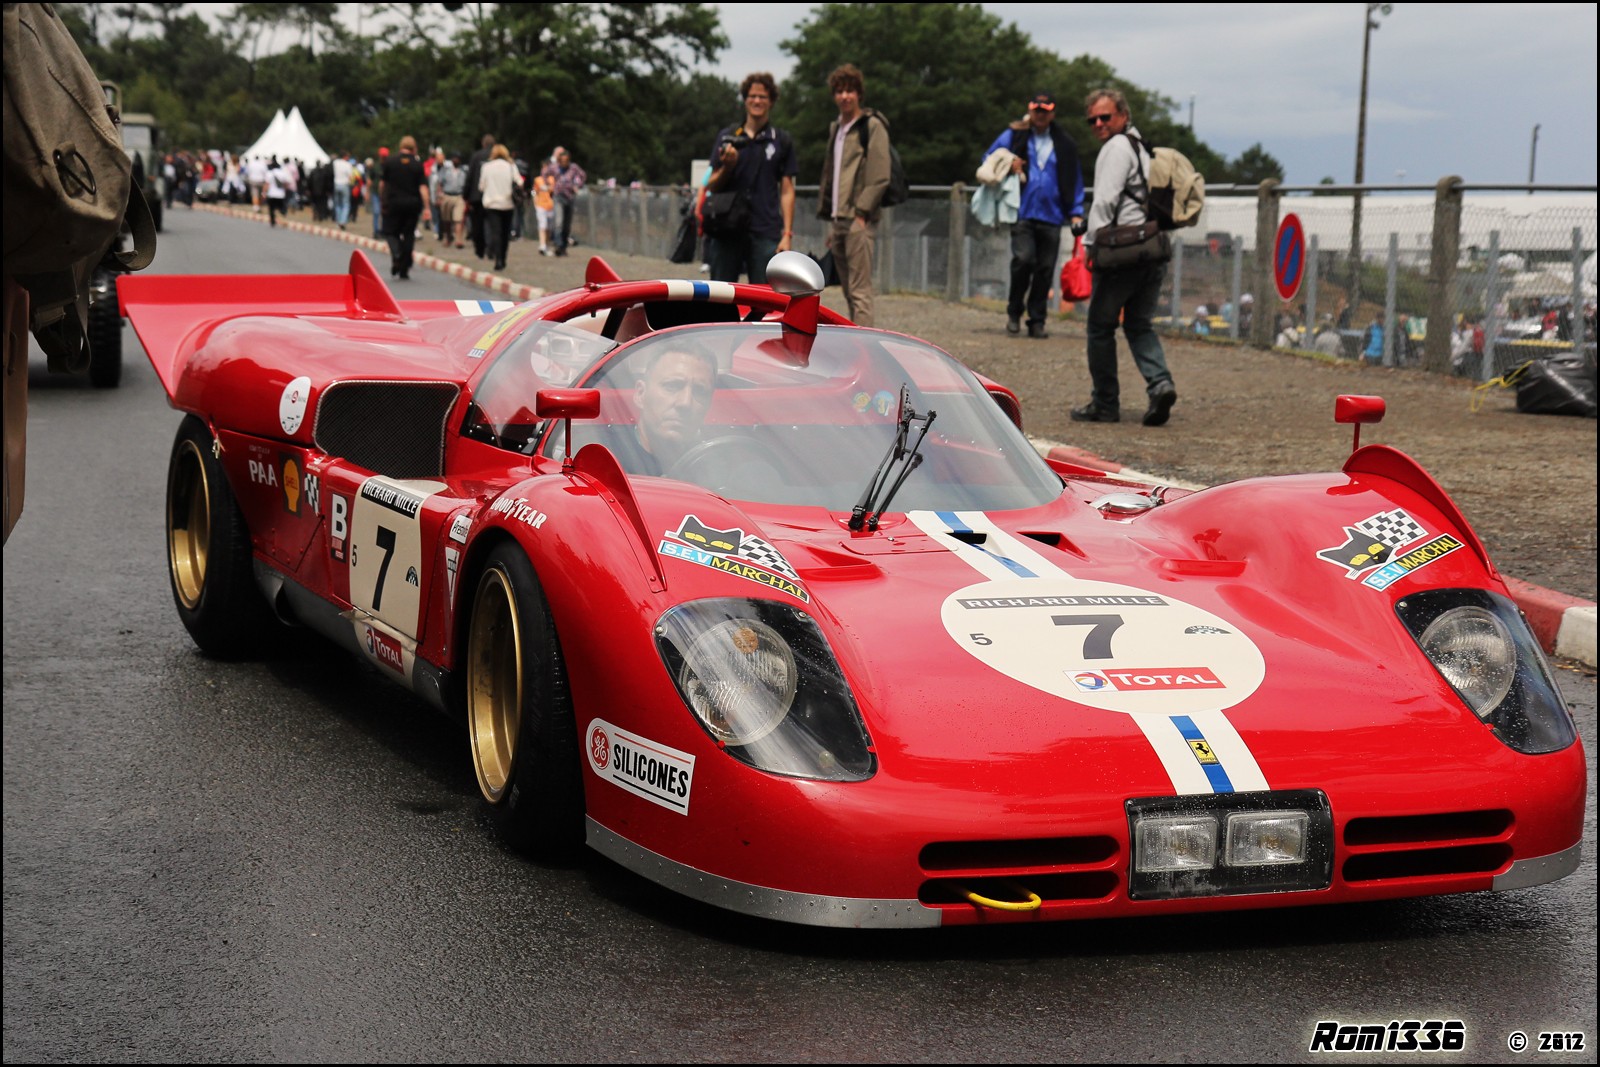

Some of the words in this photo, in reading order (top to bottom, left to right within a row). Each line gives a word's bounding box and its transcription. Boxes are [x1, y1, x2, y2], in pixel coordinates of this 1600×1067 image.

[248, 459, 278, 487] PAA
[363, 481, 396, 505] RICHARD
[394, 493, 419, 514] MILLE
[331, 493, 347, 541] B
[351, 544, 358, 567] 5
[371, 525, 397, 612] 7
[1396, 537, 1460, 570] MARCHAL
[711, 557, 806, 601] MARCHAL
[966, 597, 1079, 608] RICHARD
[1085, 596, 1164, 606] MILLE
[969, 633, 993, 646] 5
[1051, 614, 1124, 659] 7
[613, 743, 689, 798] SILICONES
